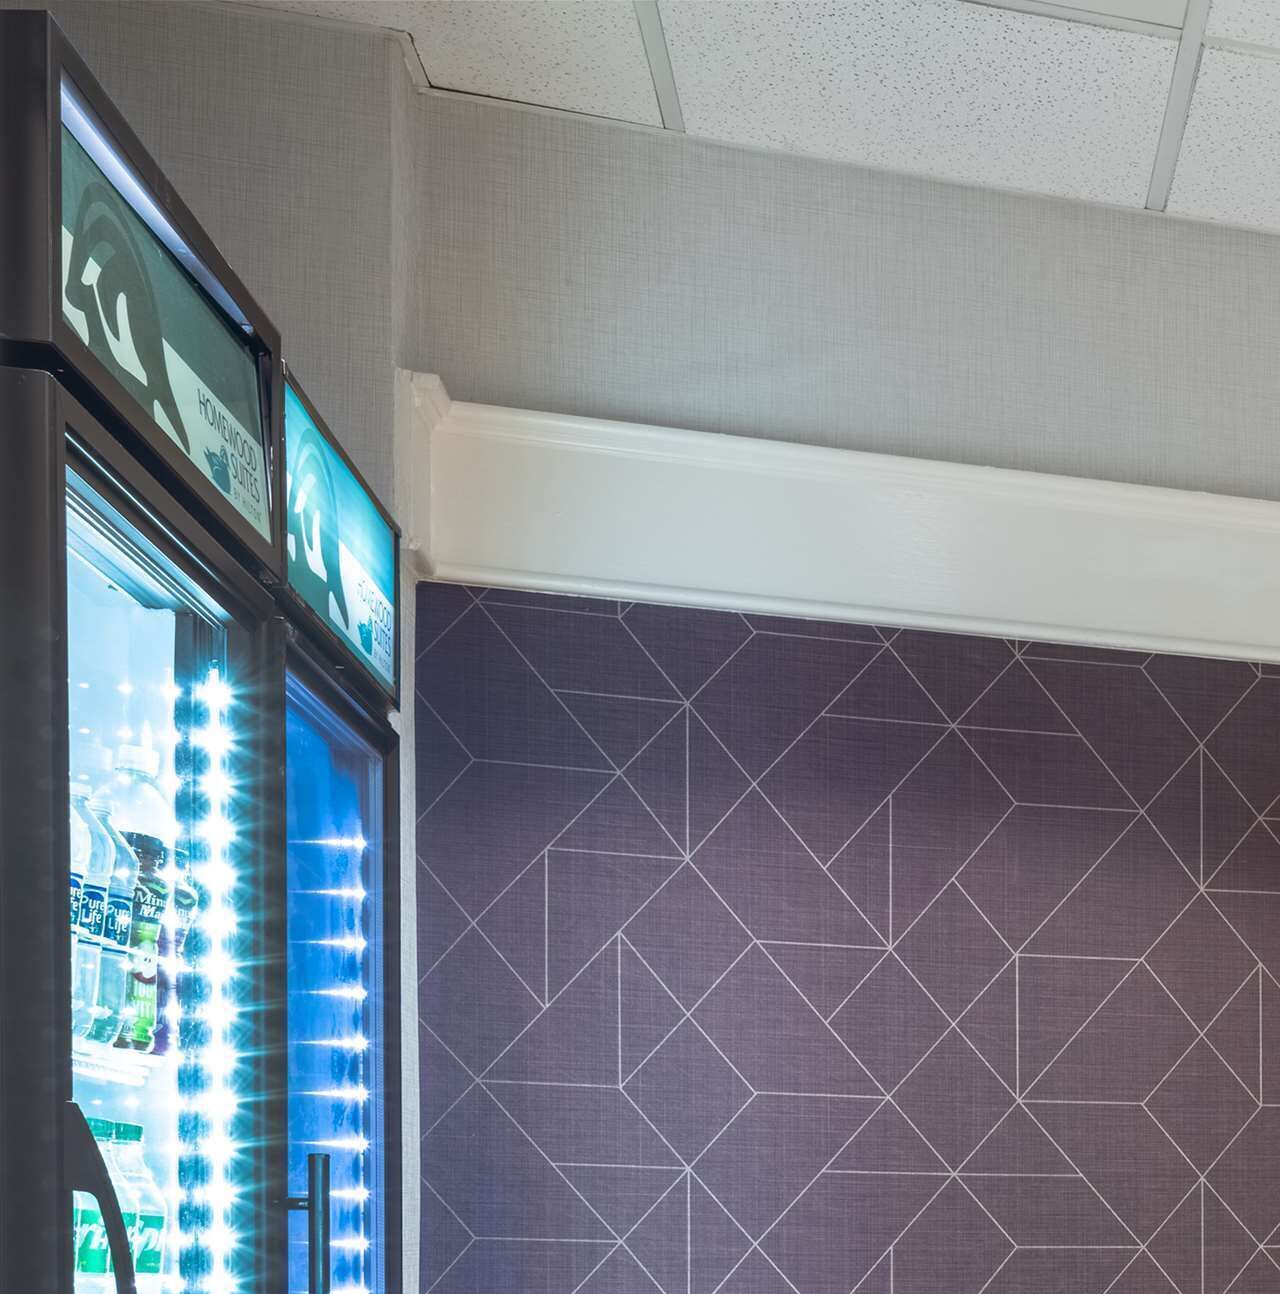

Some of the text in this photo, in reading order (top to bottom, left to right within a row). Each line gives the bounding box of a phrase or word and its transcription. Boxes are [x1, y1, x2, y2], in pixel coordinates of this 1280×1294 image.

[197, 388, 257, 473] HOMEWOOD
[230, 453, 260, 503] SUITES
[81, 893, 105, 910] Pure
[137, 888, 165, 906] Min
[81, 908, 102, 925] Life
[139, 904, 160, 919] Ma
[108, 917, 128, 933] Life
